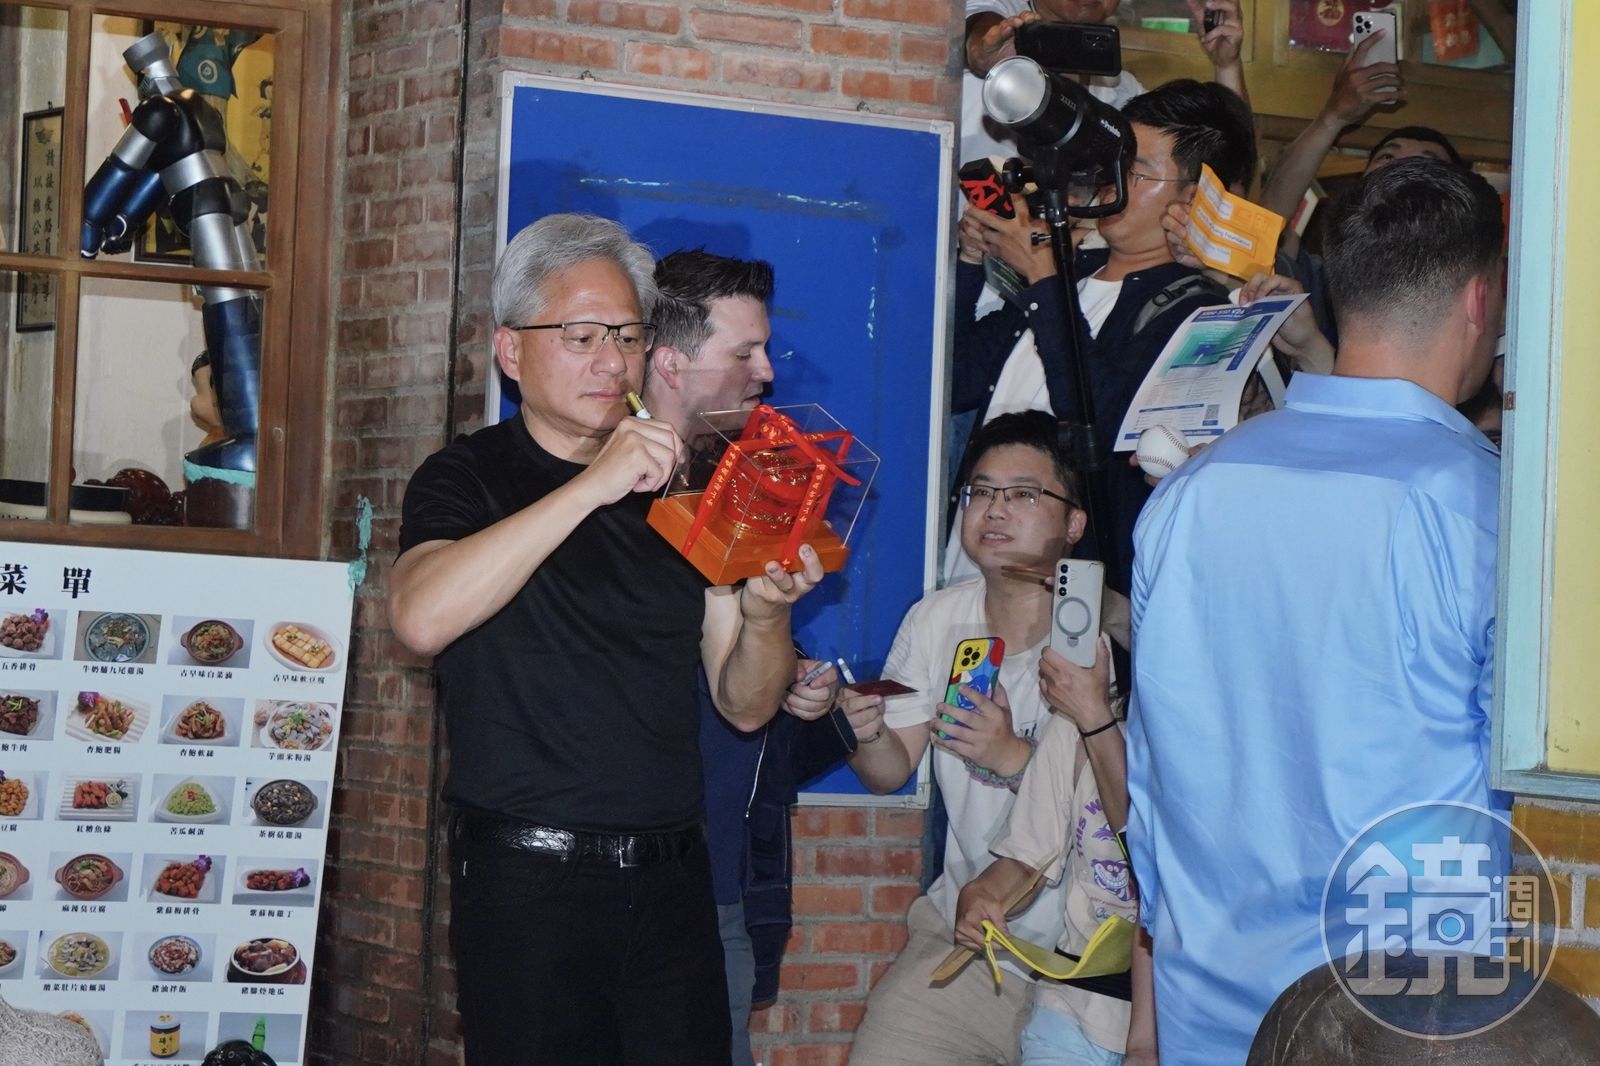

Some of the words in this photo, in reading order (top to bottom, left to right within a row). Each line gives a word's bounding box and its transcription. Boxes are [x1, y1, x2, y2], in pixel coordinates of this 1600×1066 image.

[0, 563, 93, 600] 菜單
[1, 661, 37, 672] 五香排骨
[180, 669, 234, 680] 古早味白菜滷
[86, 744, 121, 755] 杏鮑肥腸
[268, 751, 312, 763] 芋頭米粉湯
[1084, 798, 1103, 817] W
[258, 829, 303, 840] 茶樹菇雞湯
[61, 904, 107, 914] 麻辣臭豆腐
[155, 905, 200, 916] 紫蘇梅排骨
[249, 908, 294, 919] 紫蘇梅雞丁
[151, 984, 187, 993] 豬油拌飯
